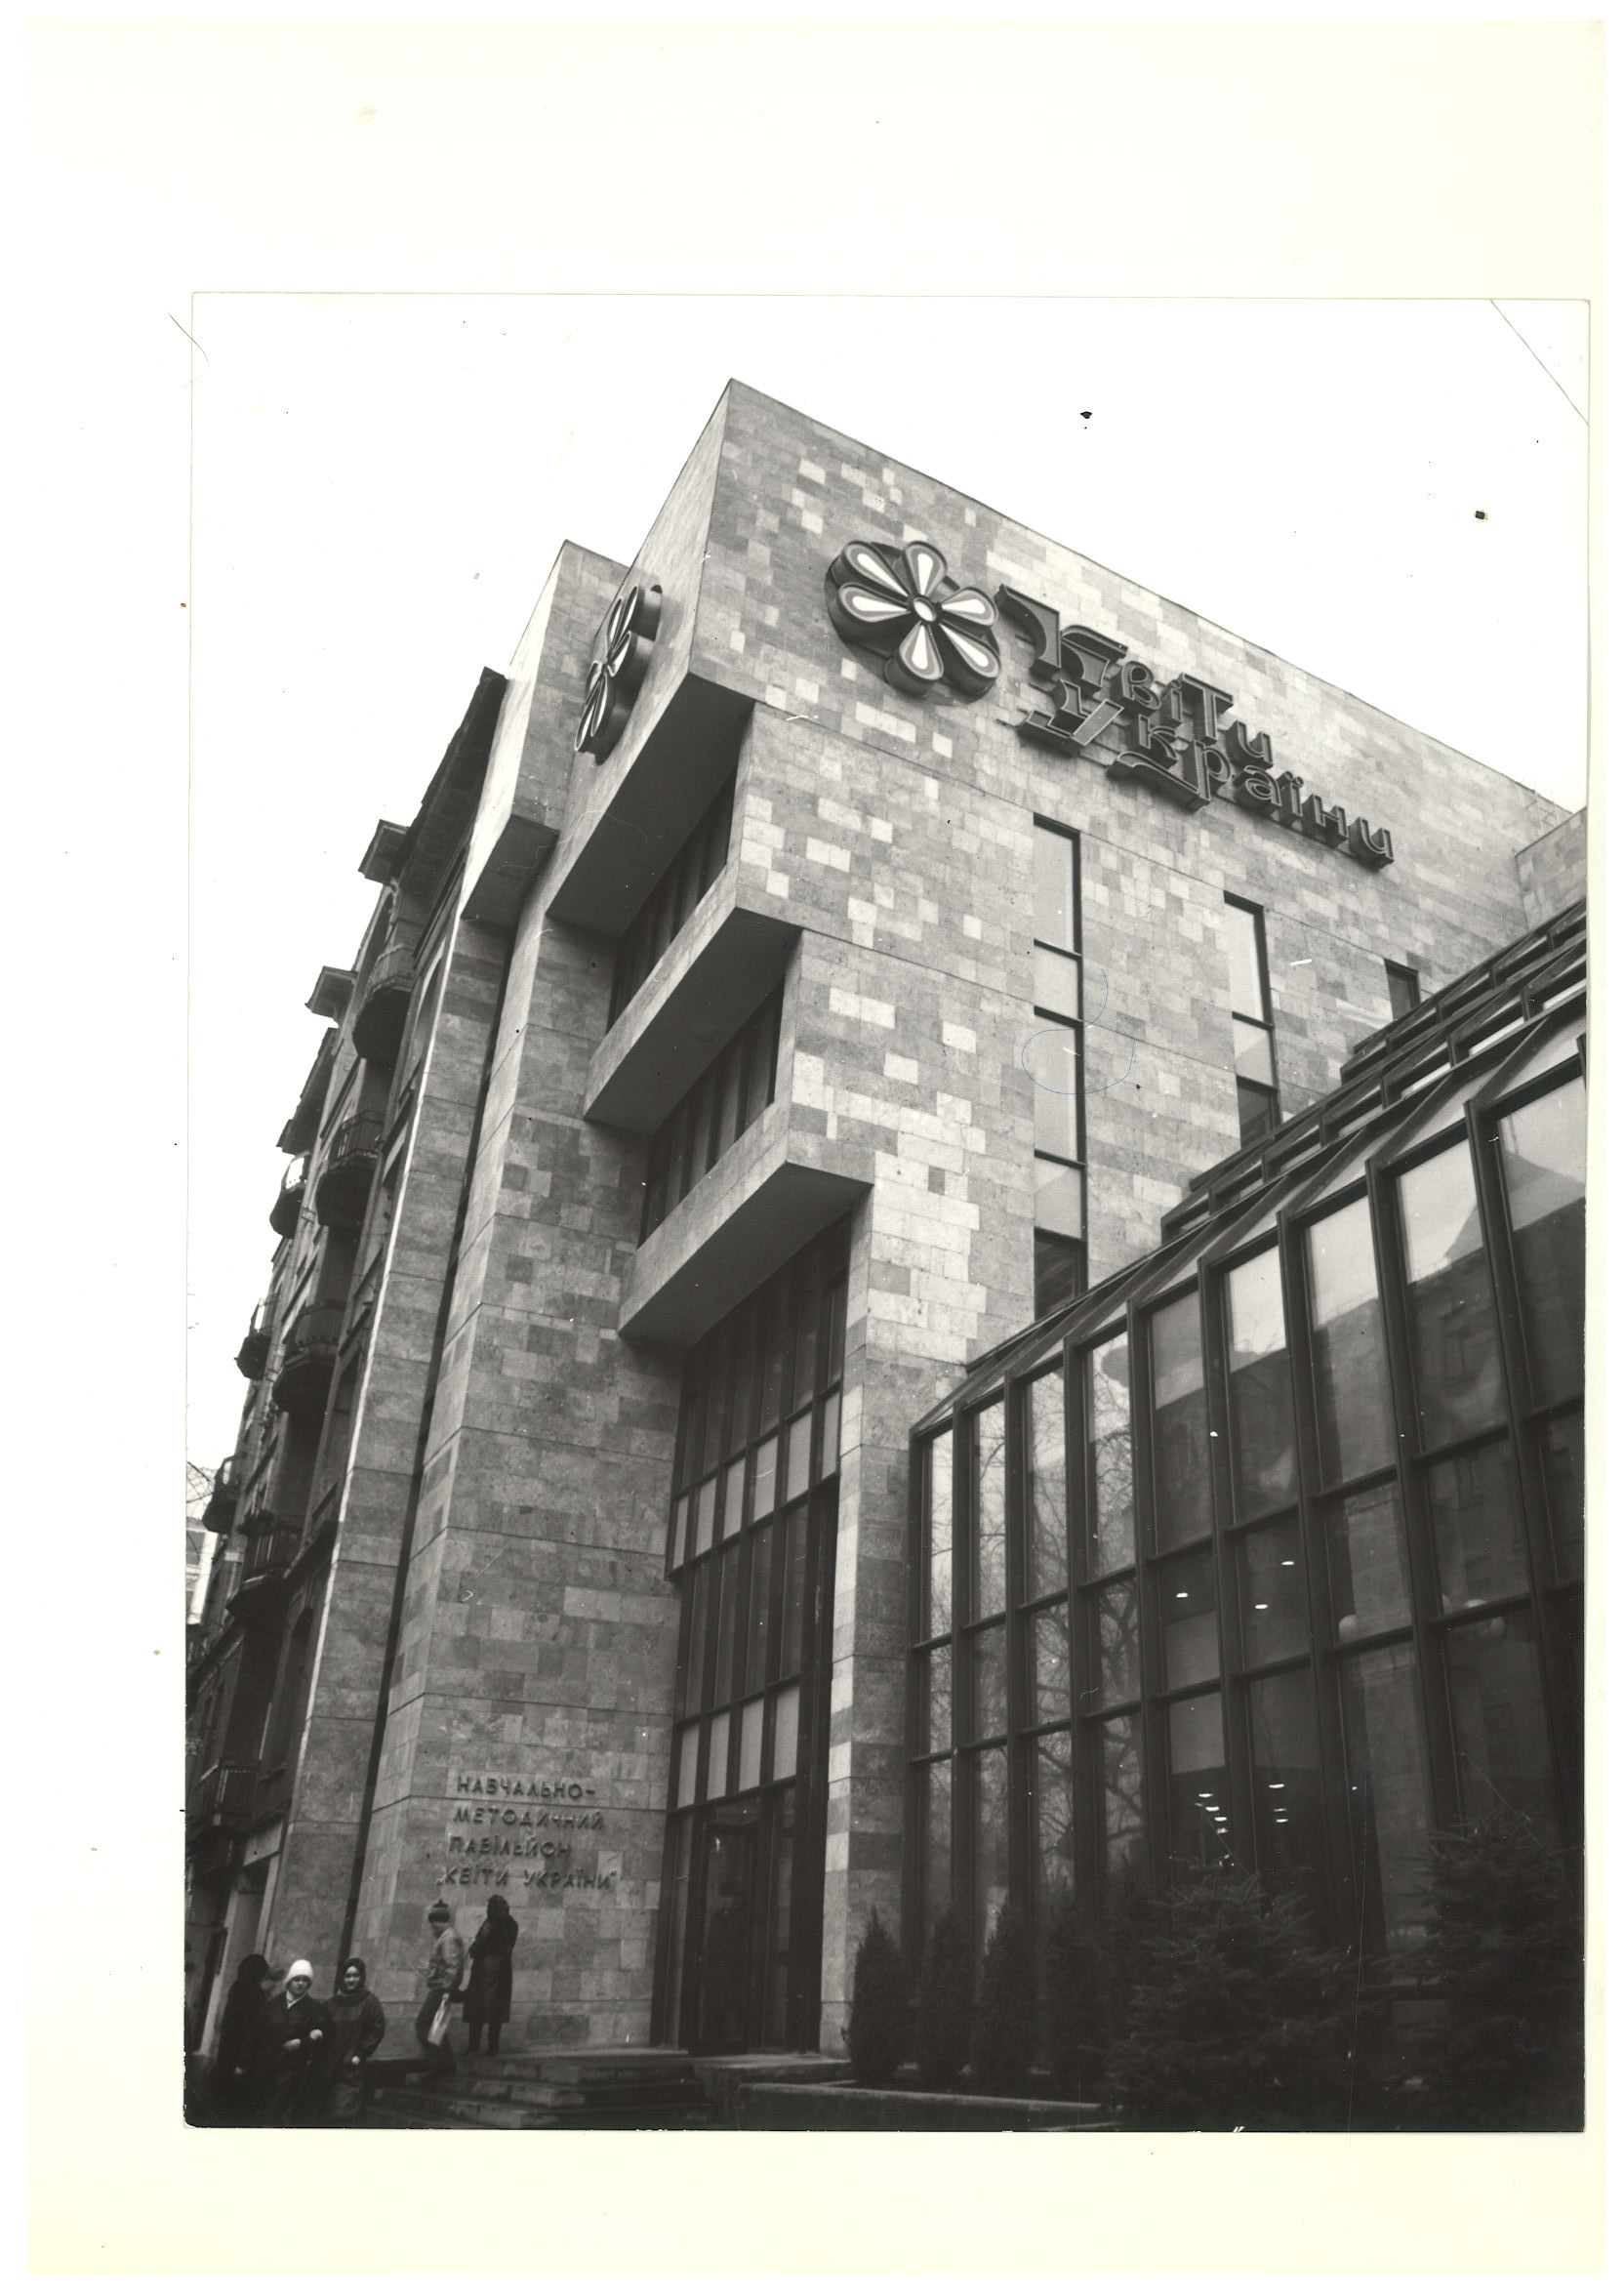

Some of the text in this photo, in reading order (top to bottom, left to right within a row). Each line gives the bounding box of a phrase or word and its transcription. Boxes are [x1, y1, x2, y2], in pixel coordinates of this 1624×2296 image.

[456, 1775, 595, 1800] НАВЧАЛЬНО-
[452, 1806, 605, 1830] МЕТОДИЧНИЙ
[448, 1834, 571, 1859] ПАВІЛЬЙОН
